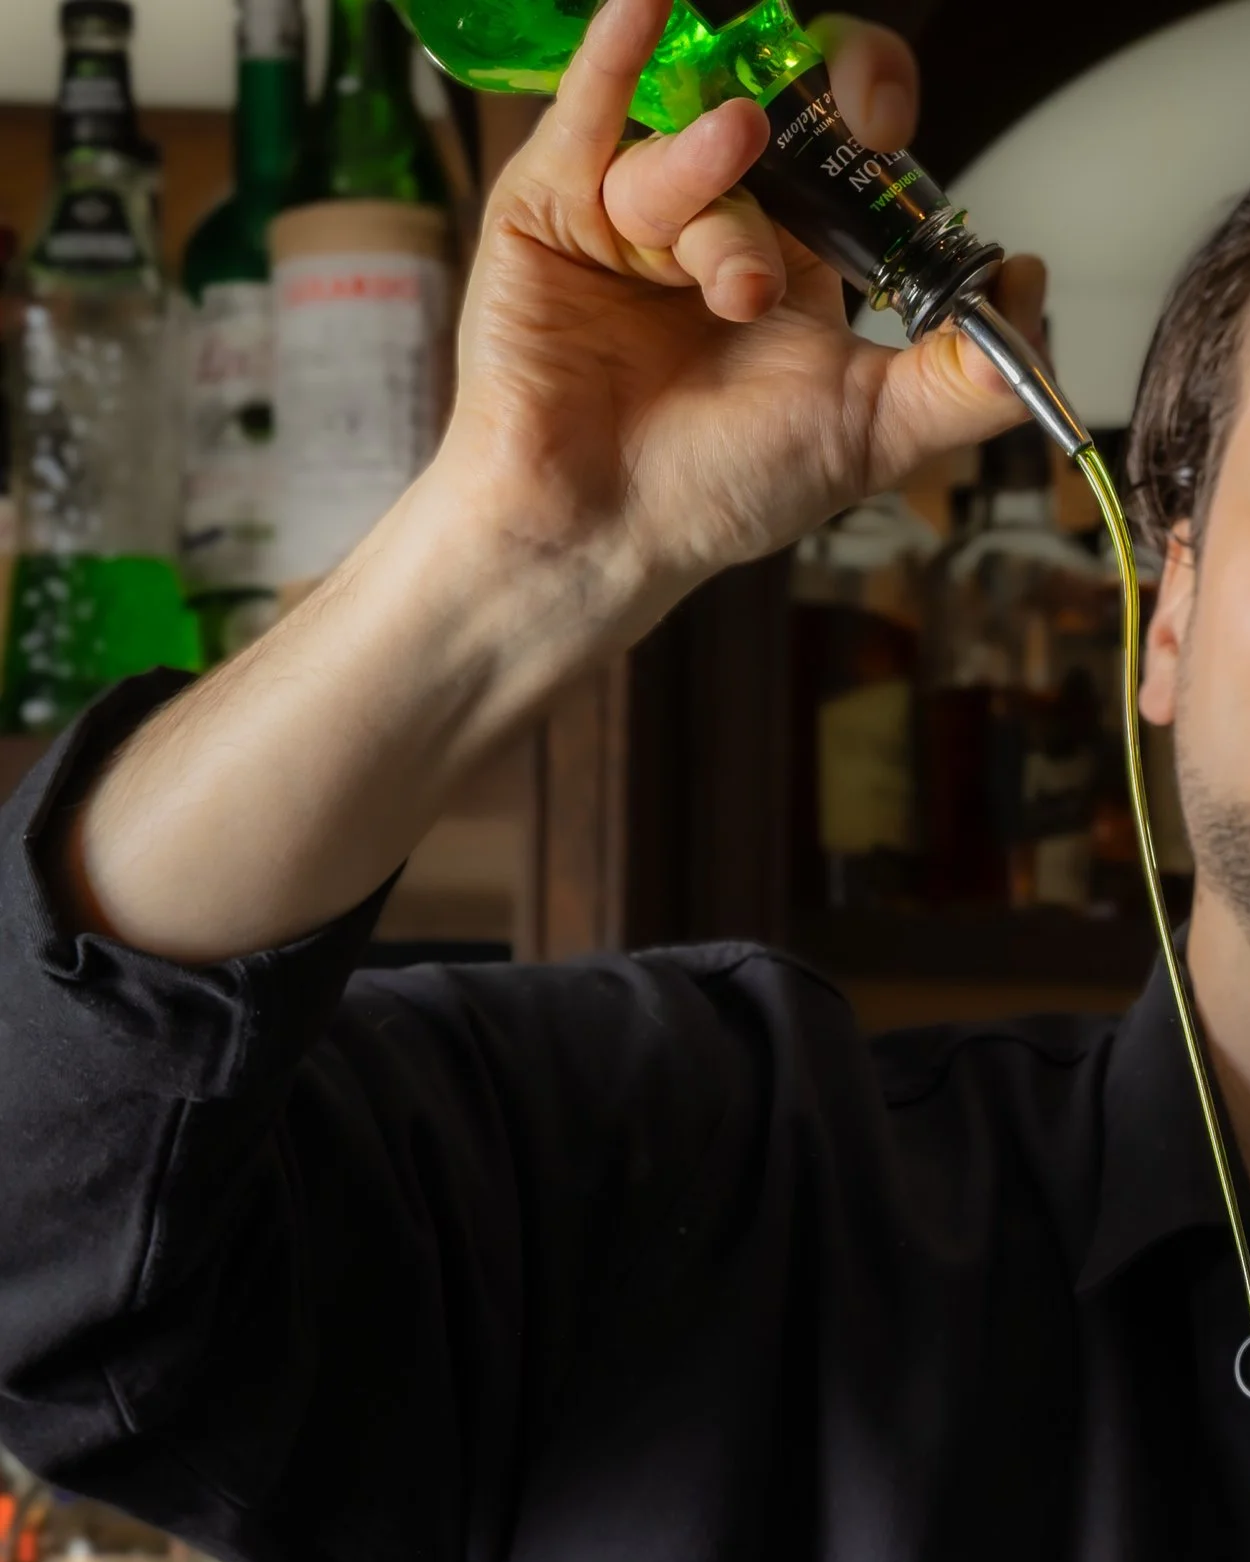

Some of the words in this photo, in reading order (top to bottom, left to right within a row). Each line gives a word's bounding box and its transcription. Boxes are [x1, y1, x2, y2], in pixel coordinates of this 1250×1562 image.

[776, 98, 827, 149] Melons
[813, 117, 835, 137] WITH
[848, 149, 908, 193] ELON
[869, 171, 918, 212] ORIGINAL
